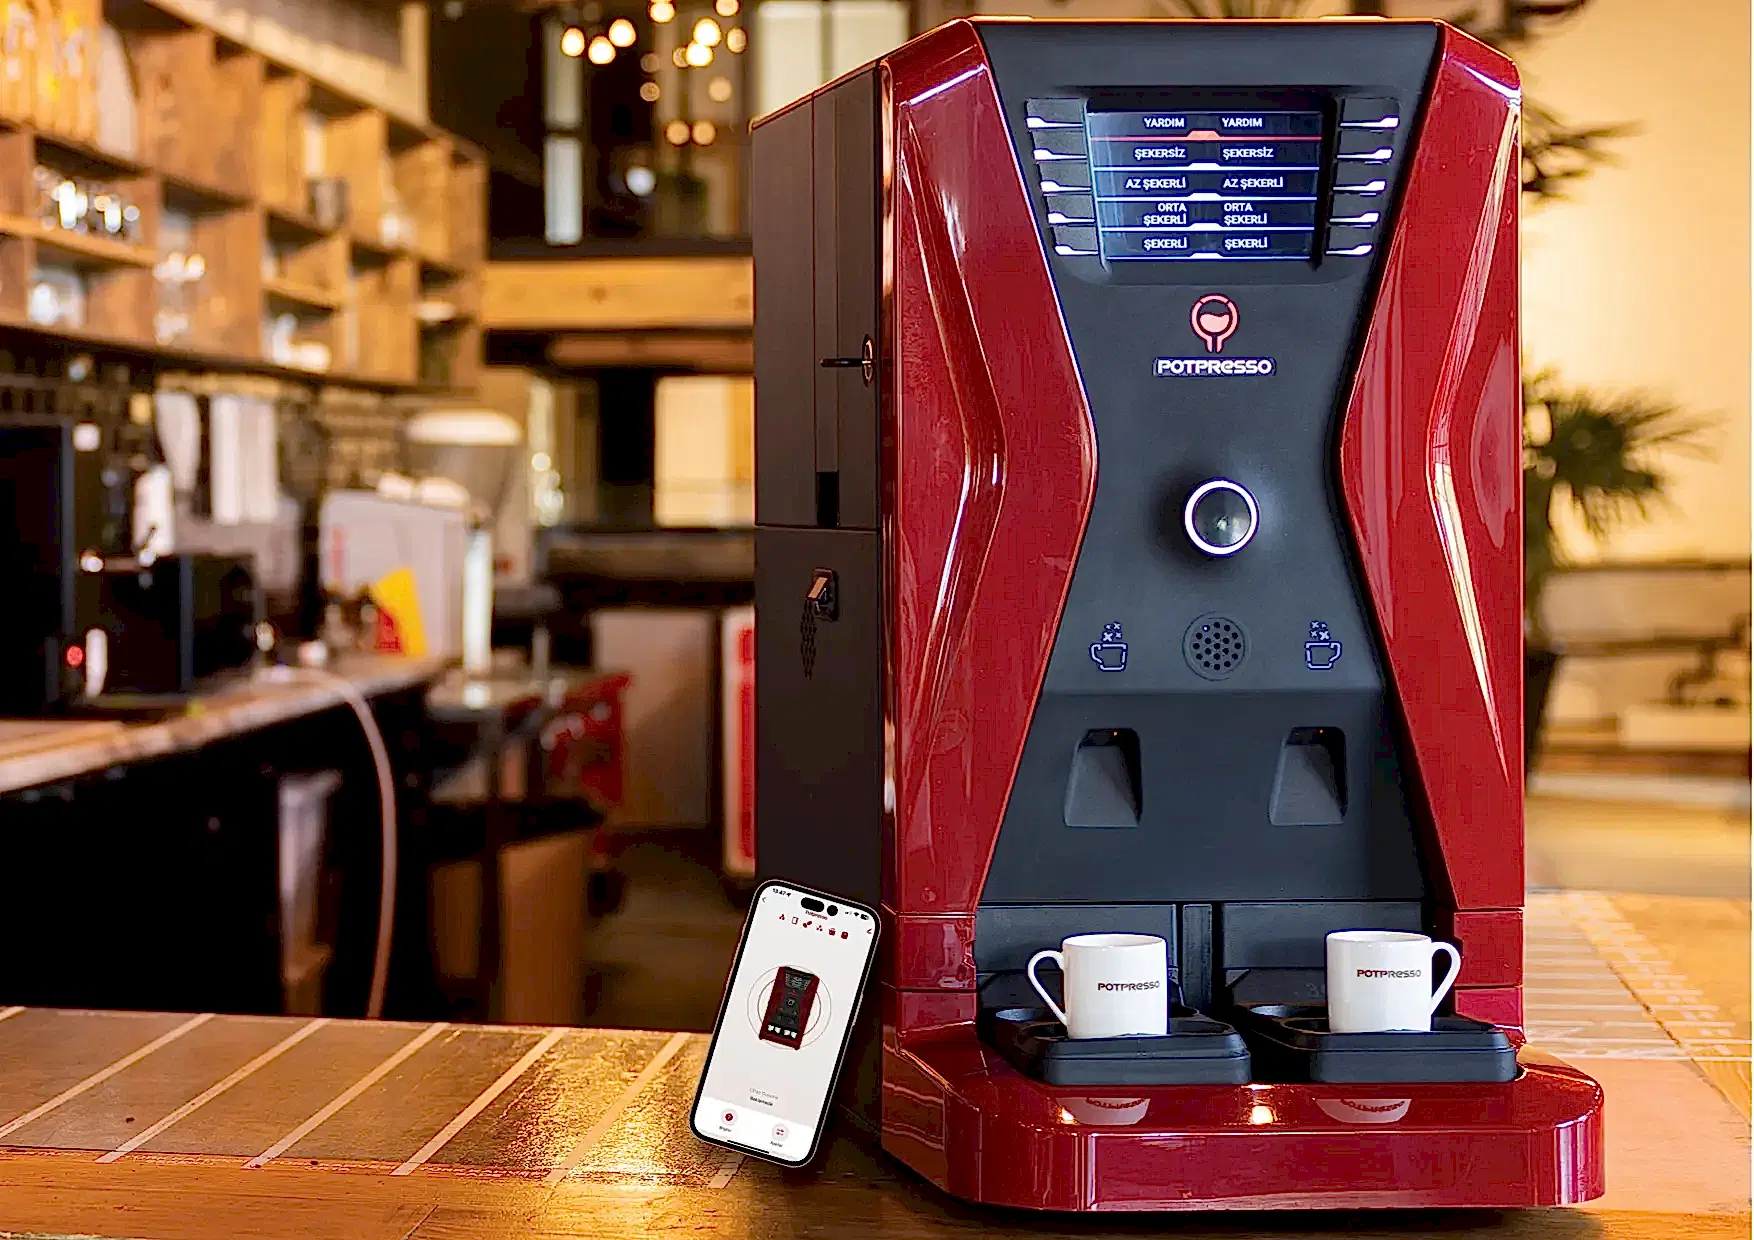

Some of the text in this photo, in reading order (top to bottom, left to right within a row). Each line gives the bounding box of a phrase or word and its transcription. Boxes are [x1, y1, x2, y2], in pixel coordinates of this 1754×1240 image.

[1143, 117, 1185, 128] YARDIM
[1221, 117, 1263, 128] YARDIM
[1134, 146, 1186, 160] ŞEKERSİZ
[1222, 146, 1274, 160] ŞEKERSİZ
[1125, 176, 1186, 190] AZ ŞEKERLİ
[1223, 176, 1284, 190] AZ ŞEKERLİ
[1157, 203, 1187, 212] ORTA
[1224, 203, 1254, 212] ORTA
[1143, 213, 1187, 226] ŞEKERLİ
[1224, 213, 1268, 226] ŞEKERLİ
[1143, 237, 1188, 250] ŞEKERLİ
[1224, 237, 1268, 250] ŞEKERLİ
